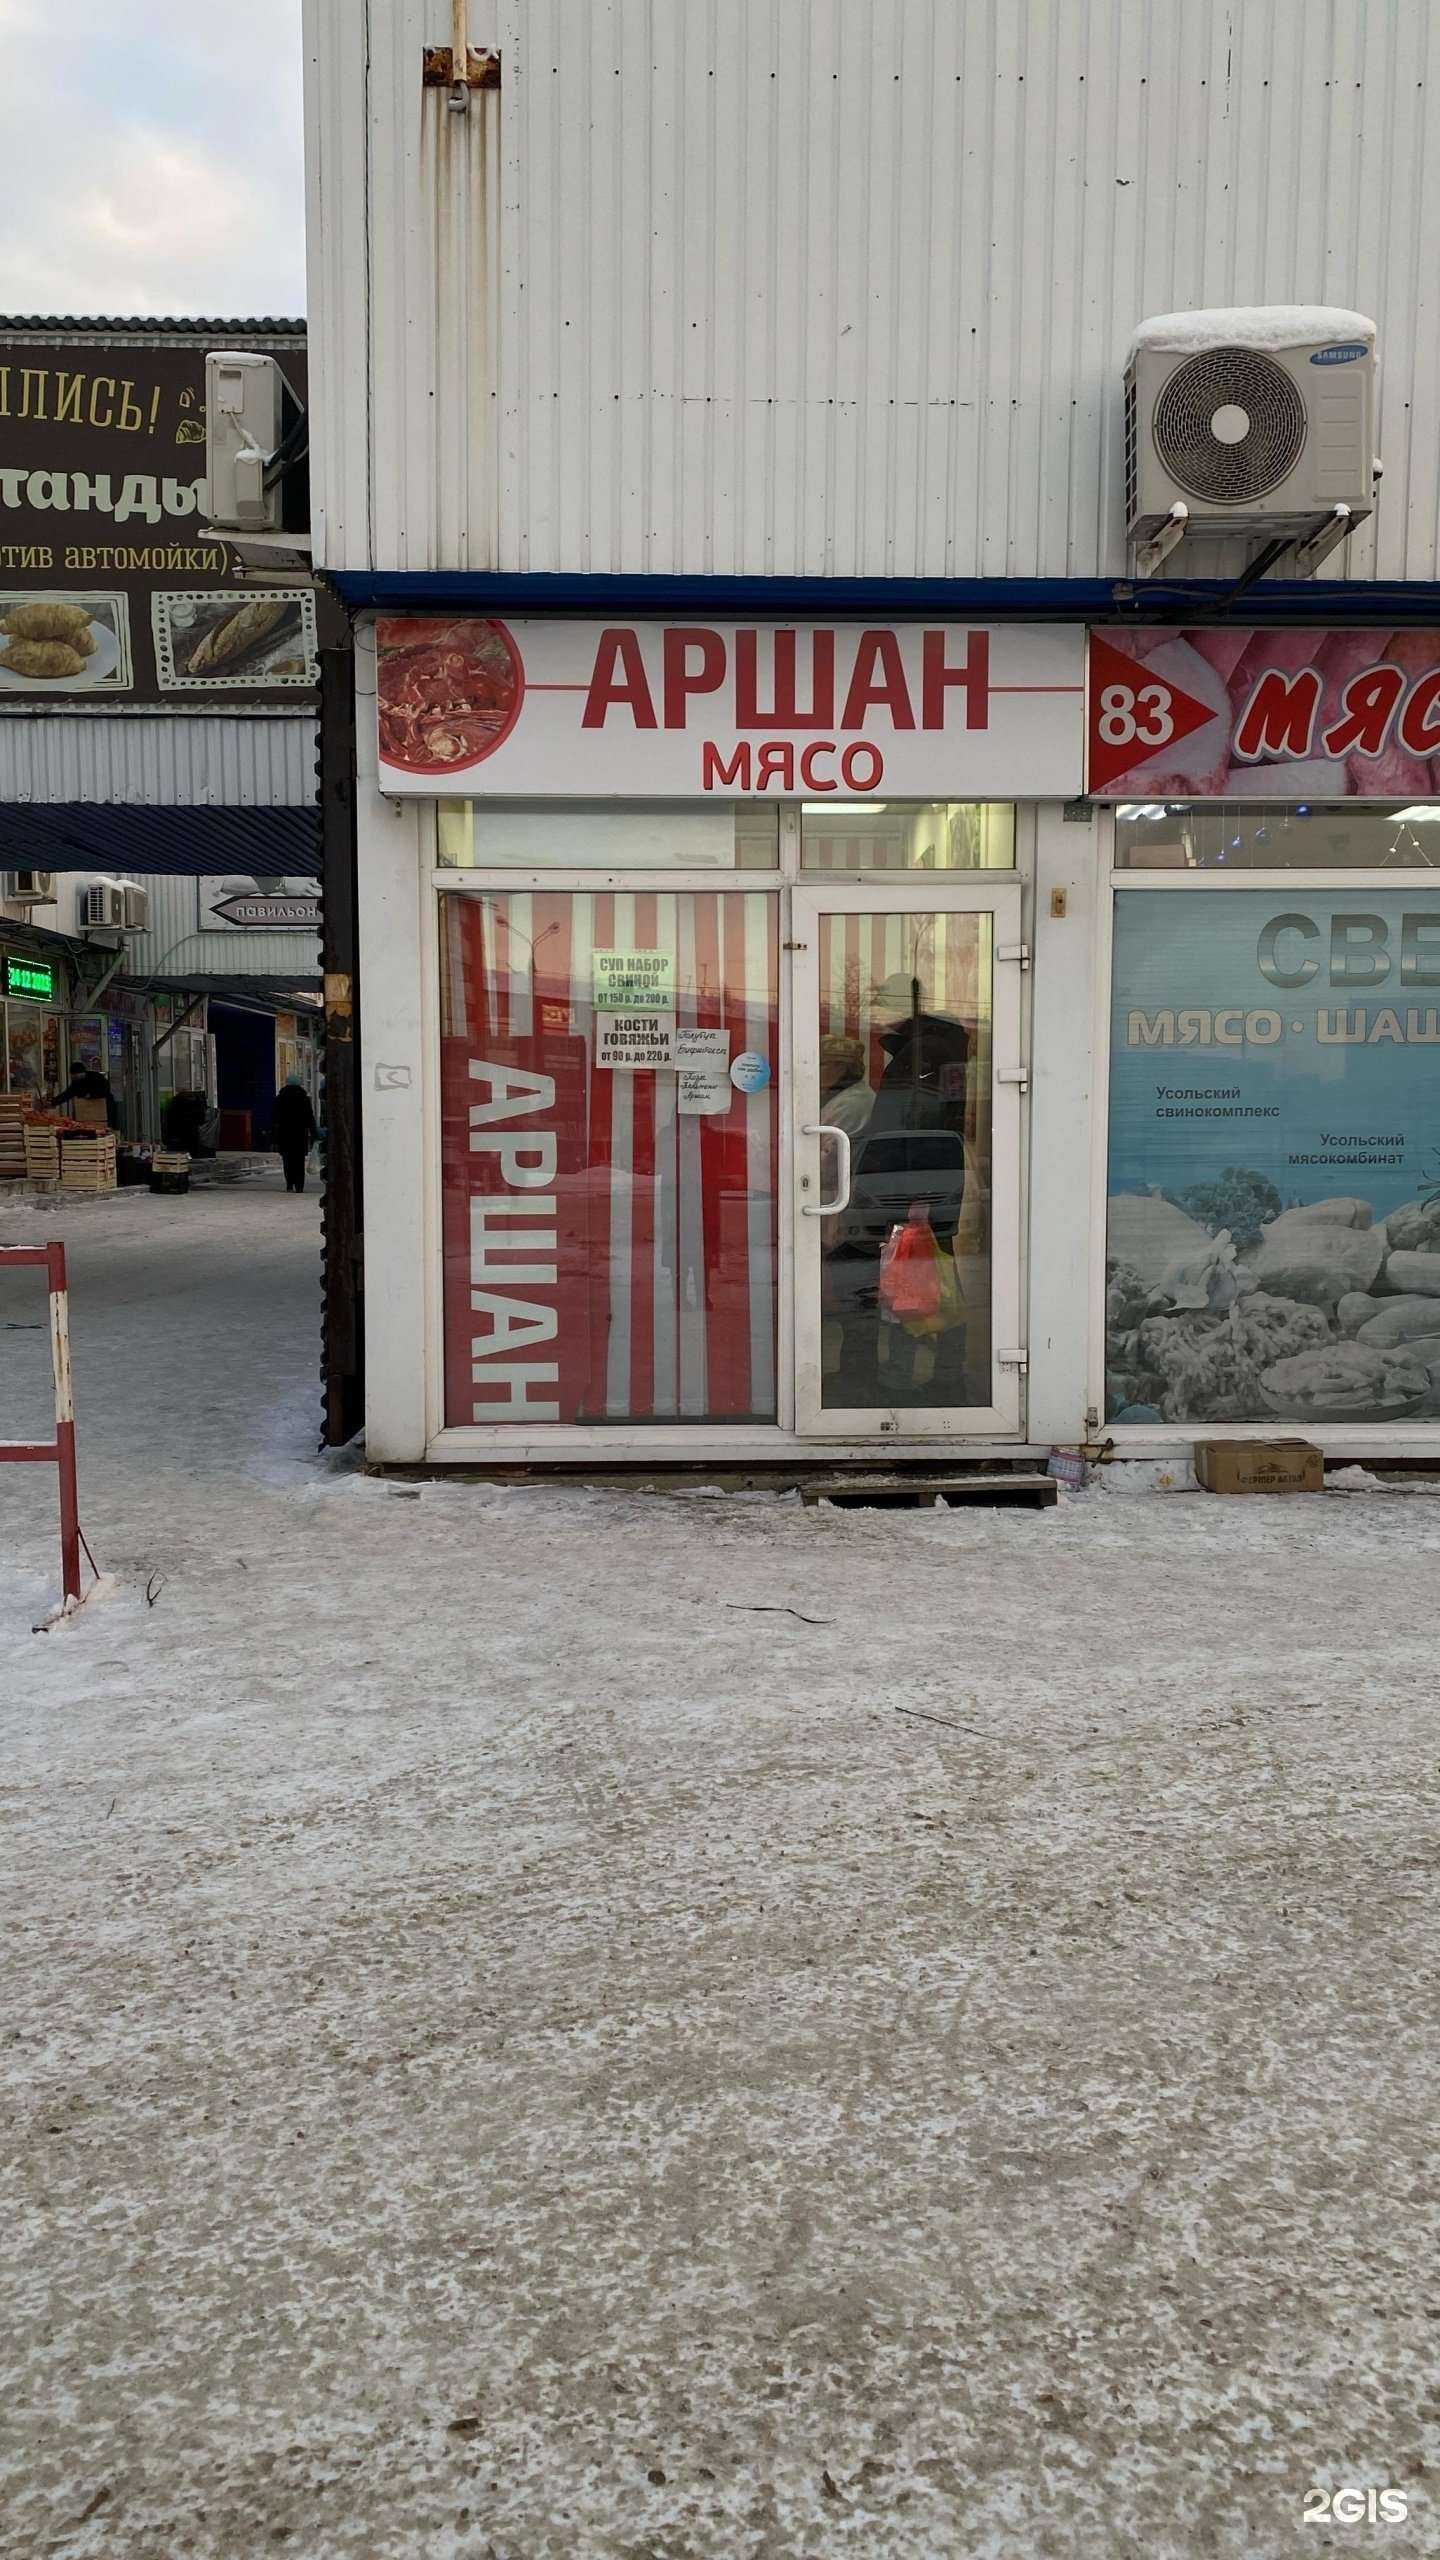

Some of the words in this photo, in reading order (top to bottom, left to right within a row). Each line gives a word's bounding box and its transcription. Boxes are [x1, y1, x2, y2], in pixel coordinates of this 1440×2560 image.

[1316, 351, 1361, 360] SAMSUNG
[0, 546, 53, 568] тив
[65, 541, 228, 576] автомойки)
[581, 627, 989, 730] АРШАН
[1098, 684, 1174, 746] 83
[703, 741, 884, 791] МЯСО
[1257, 913, 1440, 989] СВЕ
[600, 958, 624, 972] СУП
[627, 958, 669, 972] НАБОР
[614, 1019, 659, 1032] КОСТИ
[1127, 1008, 1283, 1046] МЯСО
[603, 1032, 670, 1046] ГОВЯЖЬИ
[633, 1052, 646, 1063] до
[1156, 1086, 1241, 1100] Усольский
[1156, 1104, 1280, 1118] свинокомплекс
[1320, 1133, 1405, 1147] Усольский
[1288, 1151, 1404, 1165] мясокомбинат
[468, 1058, 560, 1422] АРШАН
